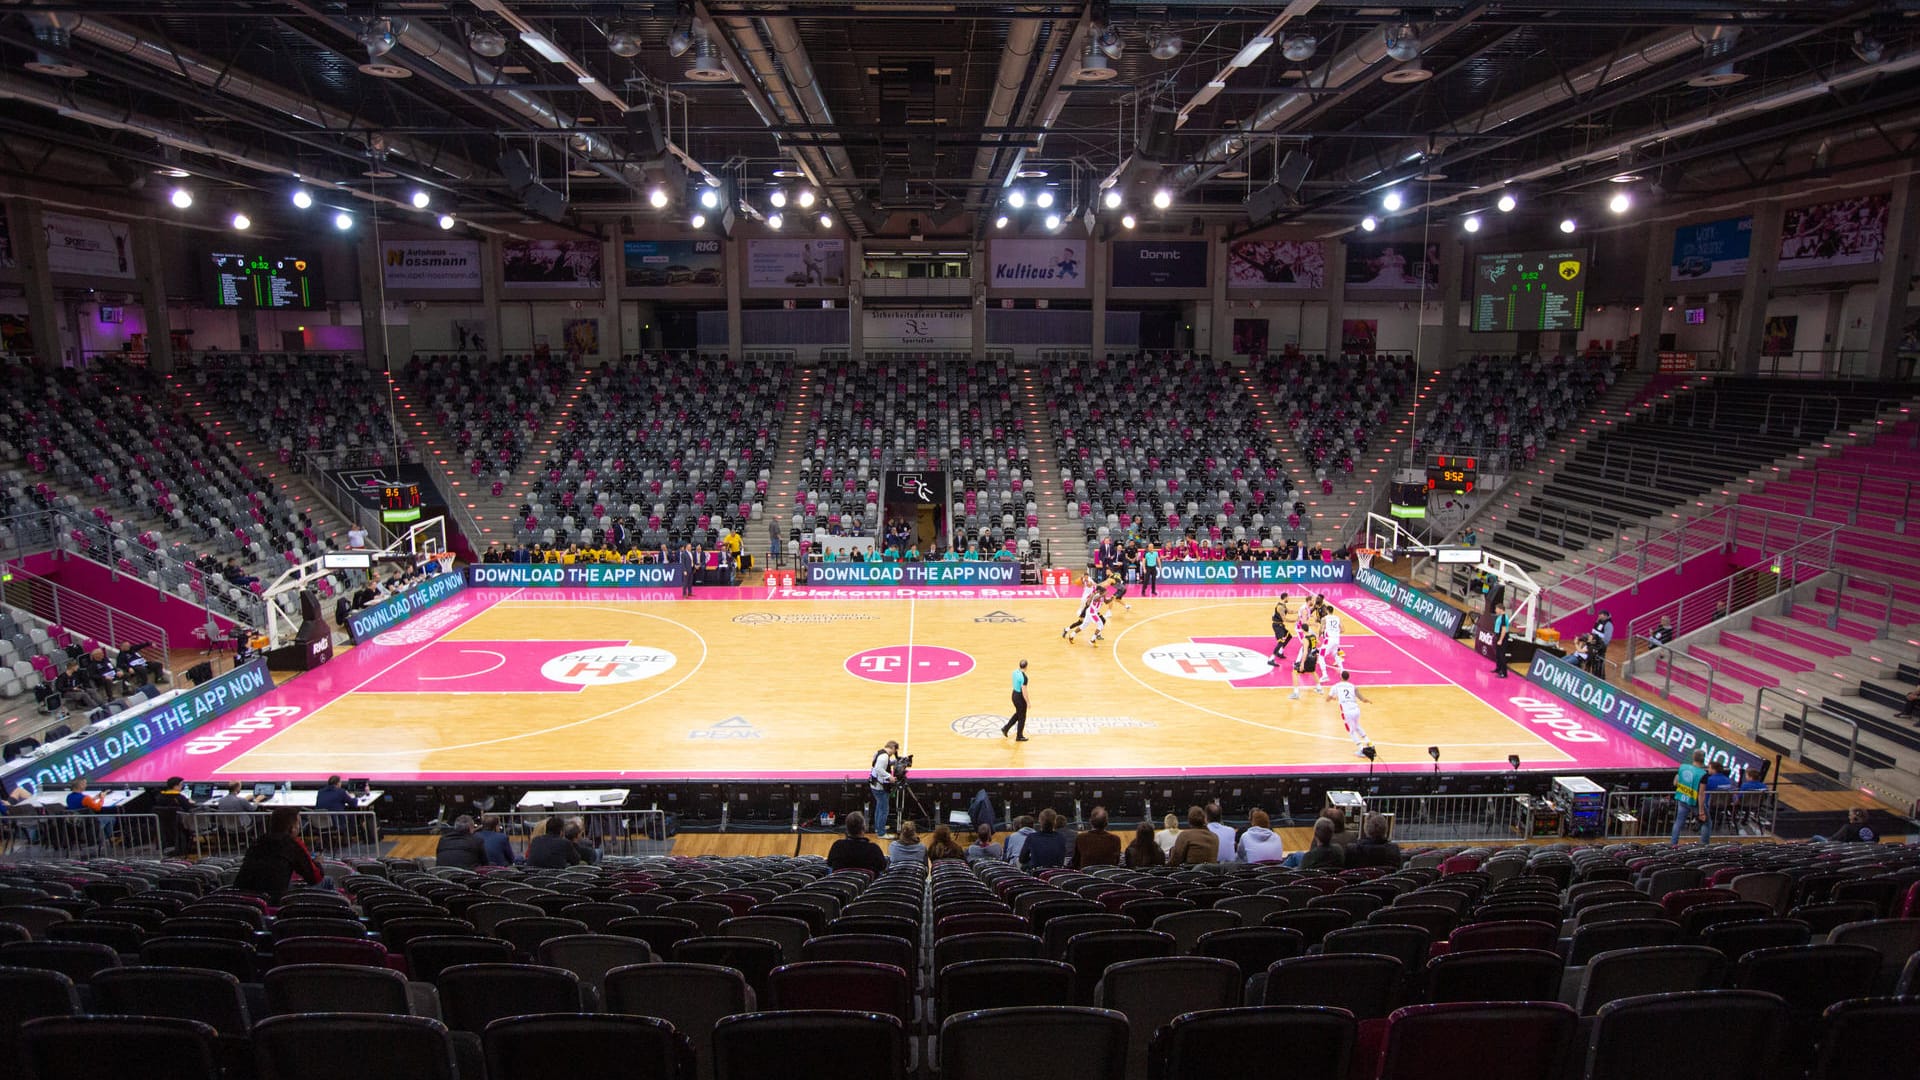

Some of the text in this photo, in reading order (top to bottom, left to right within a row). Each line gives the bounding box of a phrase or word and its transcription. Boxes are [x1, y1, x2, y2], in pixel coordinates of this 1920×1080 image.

[1140, 249, 1181, 259] Dorint
[996, 263, 1055, 279] Kulticus
[1444, 471, 1464, 481] 9:52
[475, 569, 675, 582] DOWNLOAD THE APP NOW
[813, 567, 1014, 581] DOWNLOAD THE APP NOW
[1241, 565, 1273, 579] THE
[1276, 565, 1307, 578] APP
[1311, 565, 1344, 578] NOW
[897, 588, 975, 596] Dome
[980, 588, 1050, 596] Bonn
[1355, 568, 1397, 599] DOWNLOAD
[1398, 588, 1415, 607] THE
[1414, 597, 1433, 617] APP
[1434, 607, 1456, 629] NOW
[354, 600, 411, 636] DOWNLOAD
[409, 589, 428, 608] THE
[428, 582, 445, 599] APP
[445, 571, 463, 592] NOW
[1150, 651, 1257, 659] PFLEGE
[153, 703, 194, 735] THE
[195, 685, 228, 717] APP
[229, 667, 264, 699] NOW
[1533, 658, 1616, 714] DOWNLOAD
[1617, 700, 1654, 735] THE
[1651, 720, 1697, 753] APP
[1508, 697, 1607, 742] dhpg
[184, 705, 302, 755] dhpg
